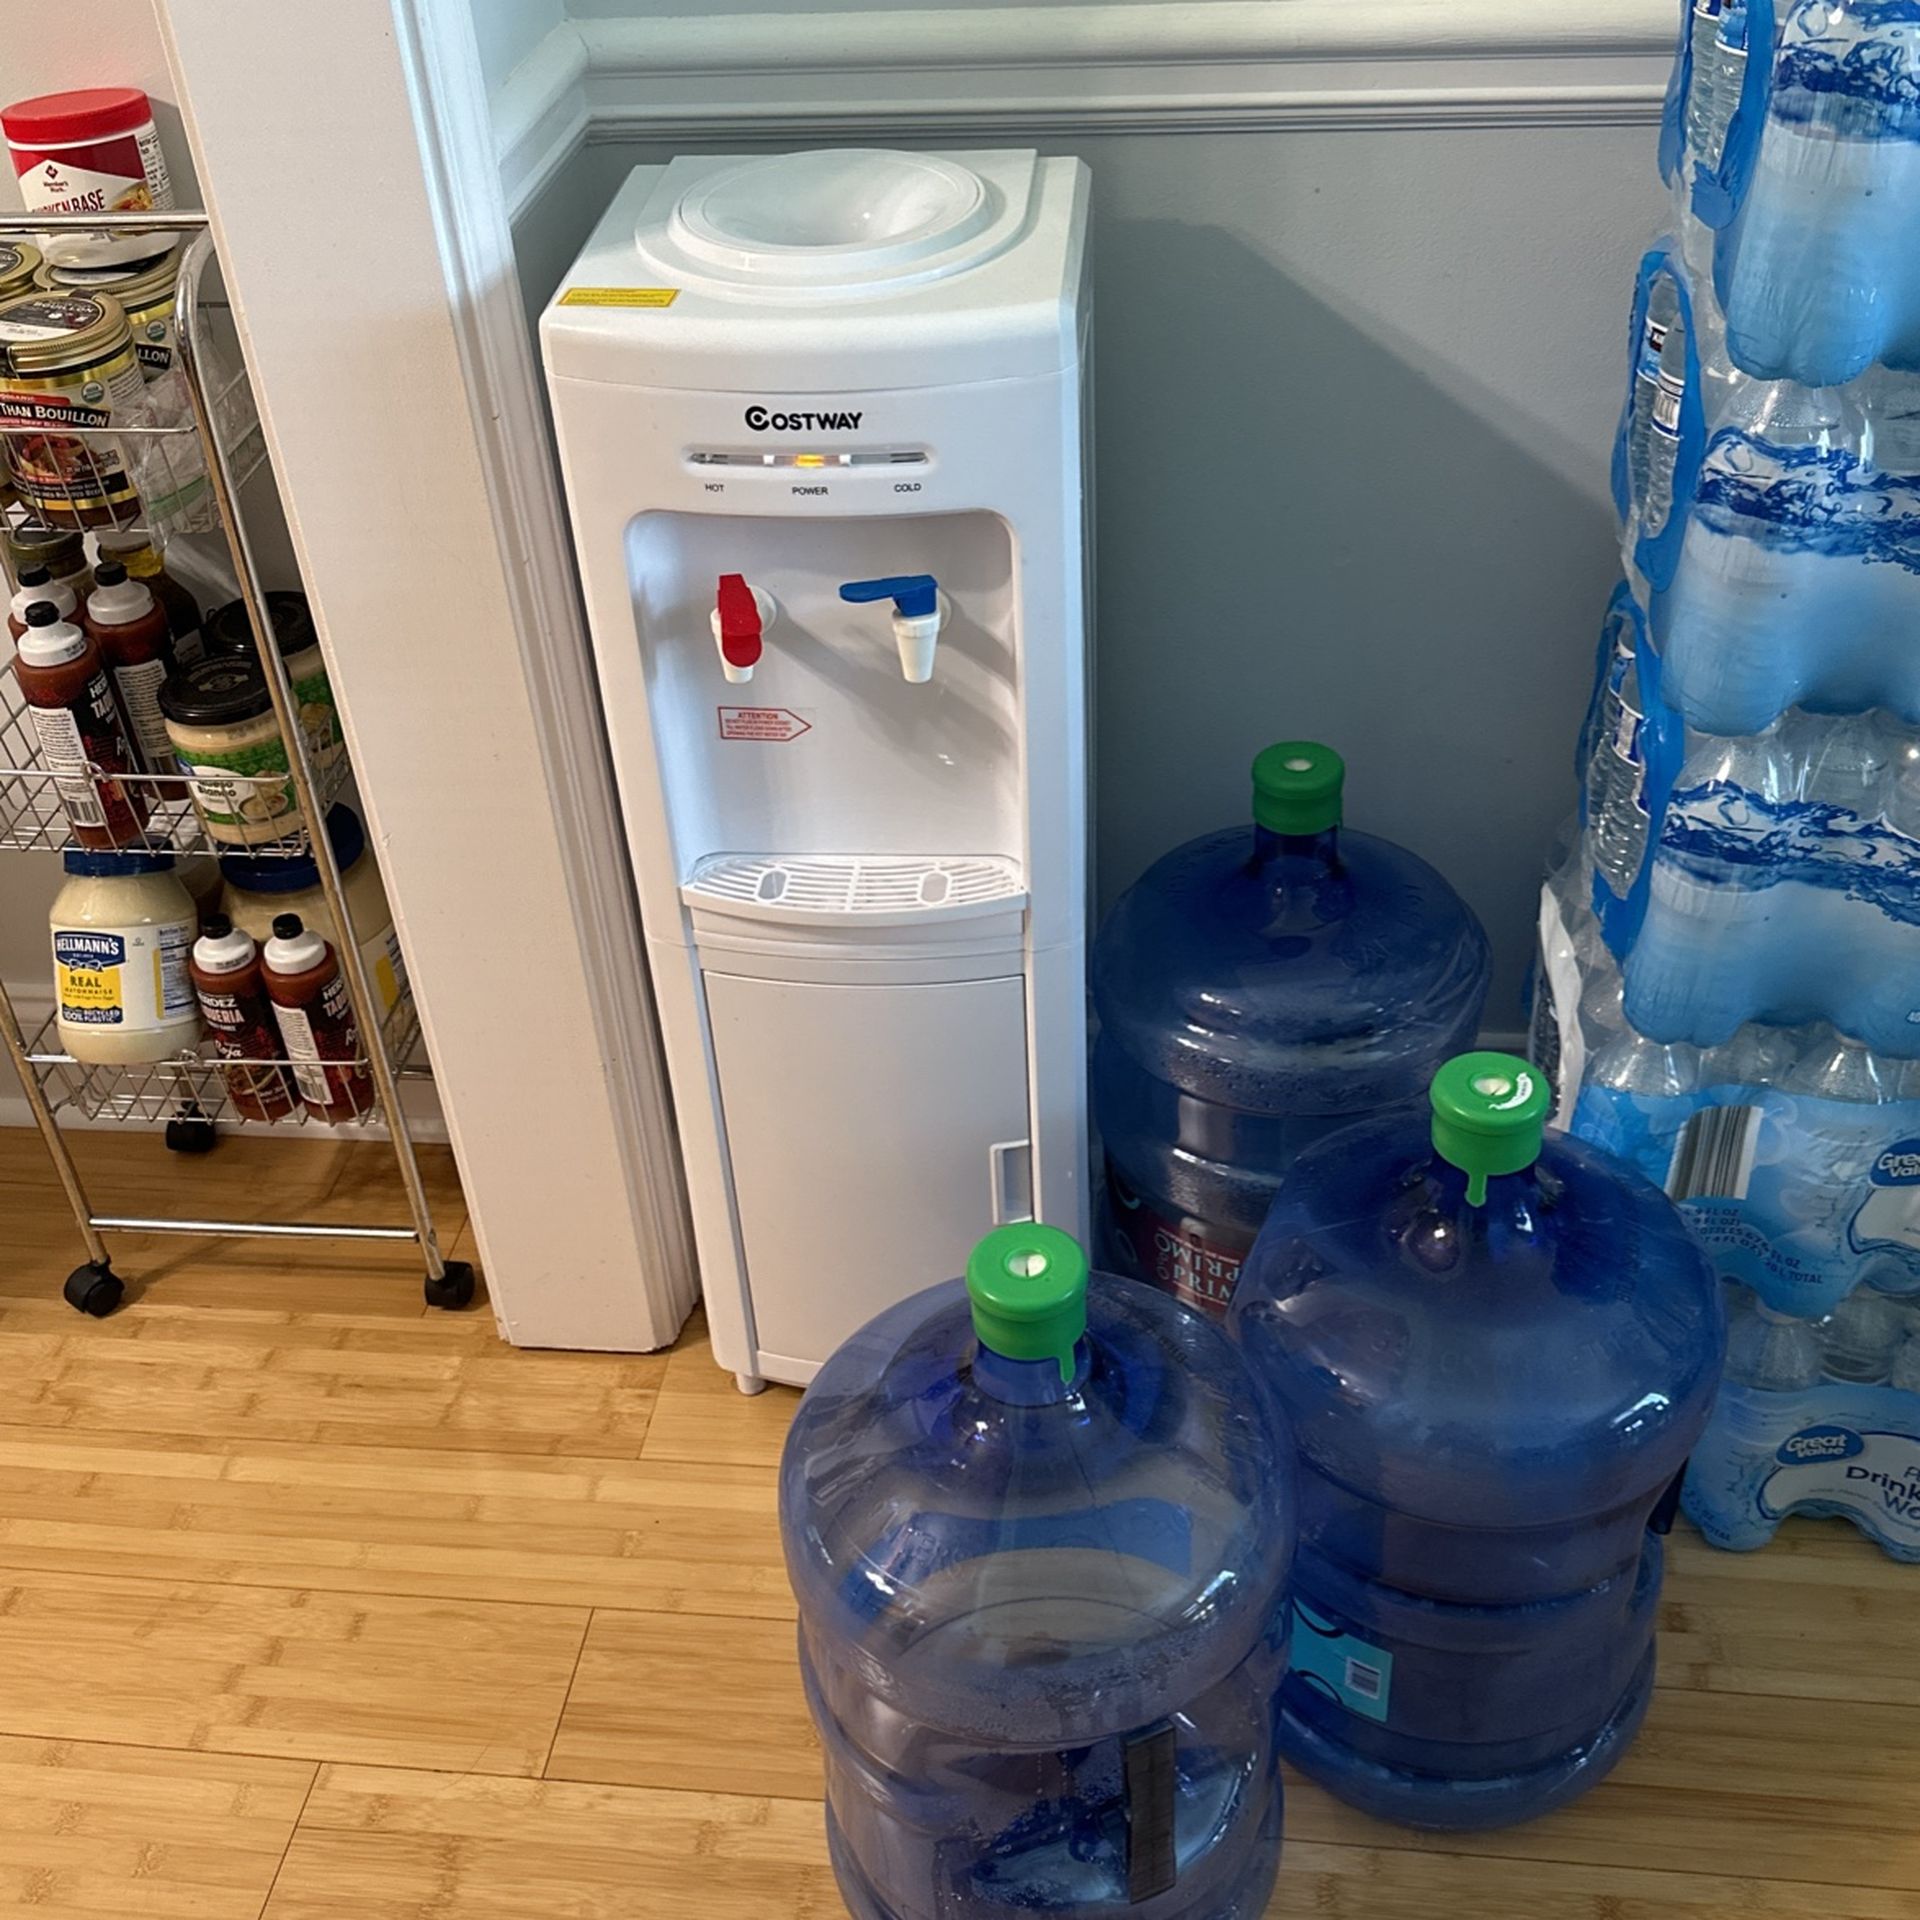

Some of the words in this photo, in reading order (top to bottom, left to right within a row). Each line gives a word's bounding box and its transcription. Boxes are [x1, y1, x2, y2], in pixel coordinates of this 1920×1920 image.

[35, 406, 108, 428] BOUILLON
[745, 406, 863, 432] COSTWAY
[705, 484, 725, 493] HOT
[792, 487, 829, 496] POWER
[894, 483, 922, 493] COLD
[738, 712, 779, 720] ATTENTION
[57, 937, 120, 956] HELLMANN'S
[70, 976, 102, 988] REAL
[1785, 1434, 1848, 1453] Great
[1797, 1448, 1845, 1459] Value
